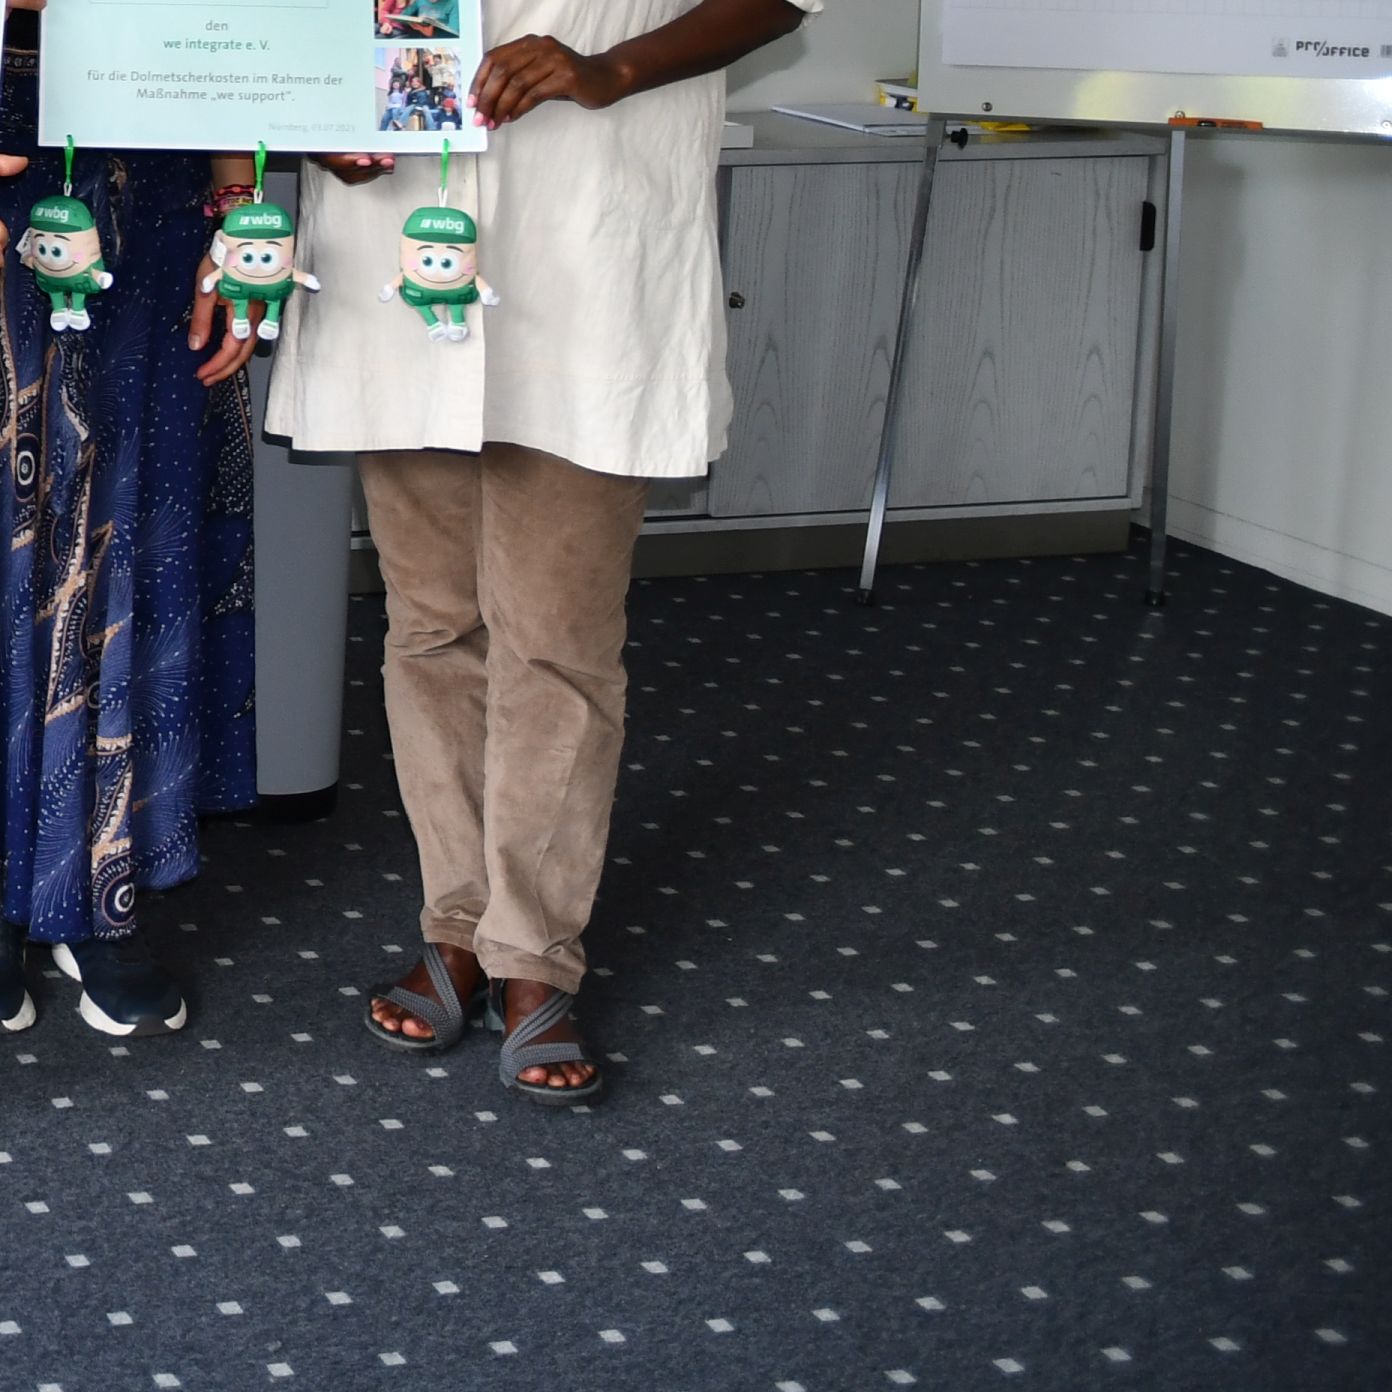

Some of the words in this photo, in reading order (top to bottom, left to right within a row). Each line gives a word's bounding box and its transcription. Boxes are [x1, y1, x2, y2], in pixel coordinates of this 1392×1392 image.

[206, 20, 228, 31] den
[163, 41, 181, 49] we
[186, 39, 242, 52] integrate
[88, 70, 104, 80] für
[109, 71, 126, 81] die
[131, 71, 249, 83] Dolmetscherkosten
[253, 74, 268, 83] im
[272, 73, 320, 84] Rahmen
[324, 74, 342, 85] der
[136, 88, 207, 99] Maßnahme
